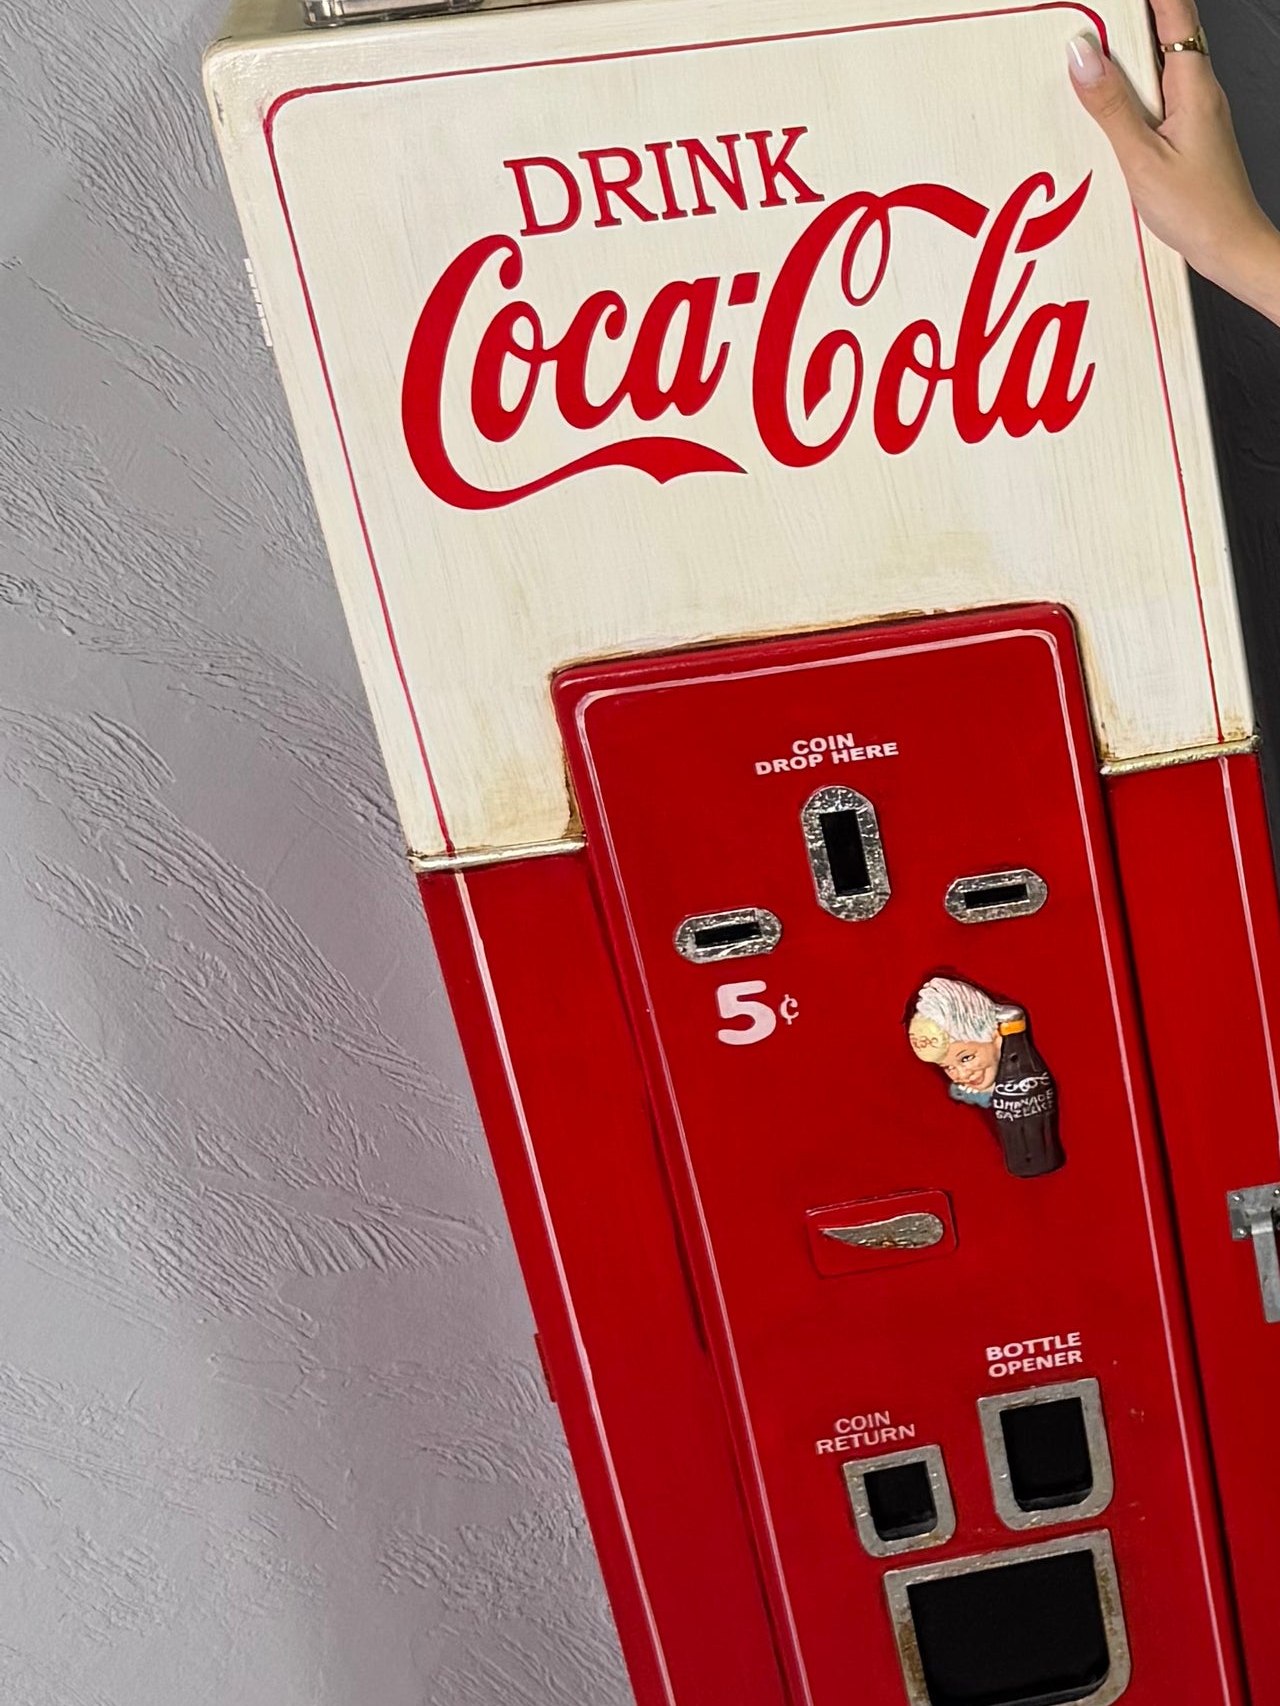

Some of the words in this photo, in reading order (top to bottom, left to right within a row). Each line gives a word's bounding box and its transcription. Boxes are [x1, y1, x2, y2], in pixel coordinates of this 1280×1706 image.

[502, 125, 824, 237] DRINK
[401, 169, 1096, 511] Coca-Cola
[754, 751, 824, 776] DROP
[831, 741, 899, 766] HERE
[791, 733, 855, 755] COIN
[985, 1331, 1083, 1366] BOTTLE
[987, 1349, 1084, 1380] OPENER
[814, 1421, 916, 1456] RETURN
[833, 1409, 891, 1438] COIN
